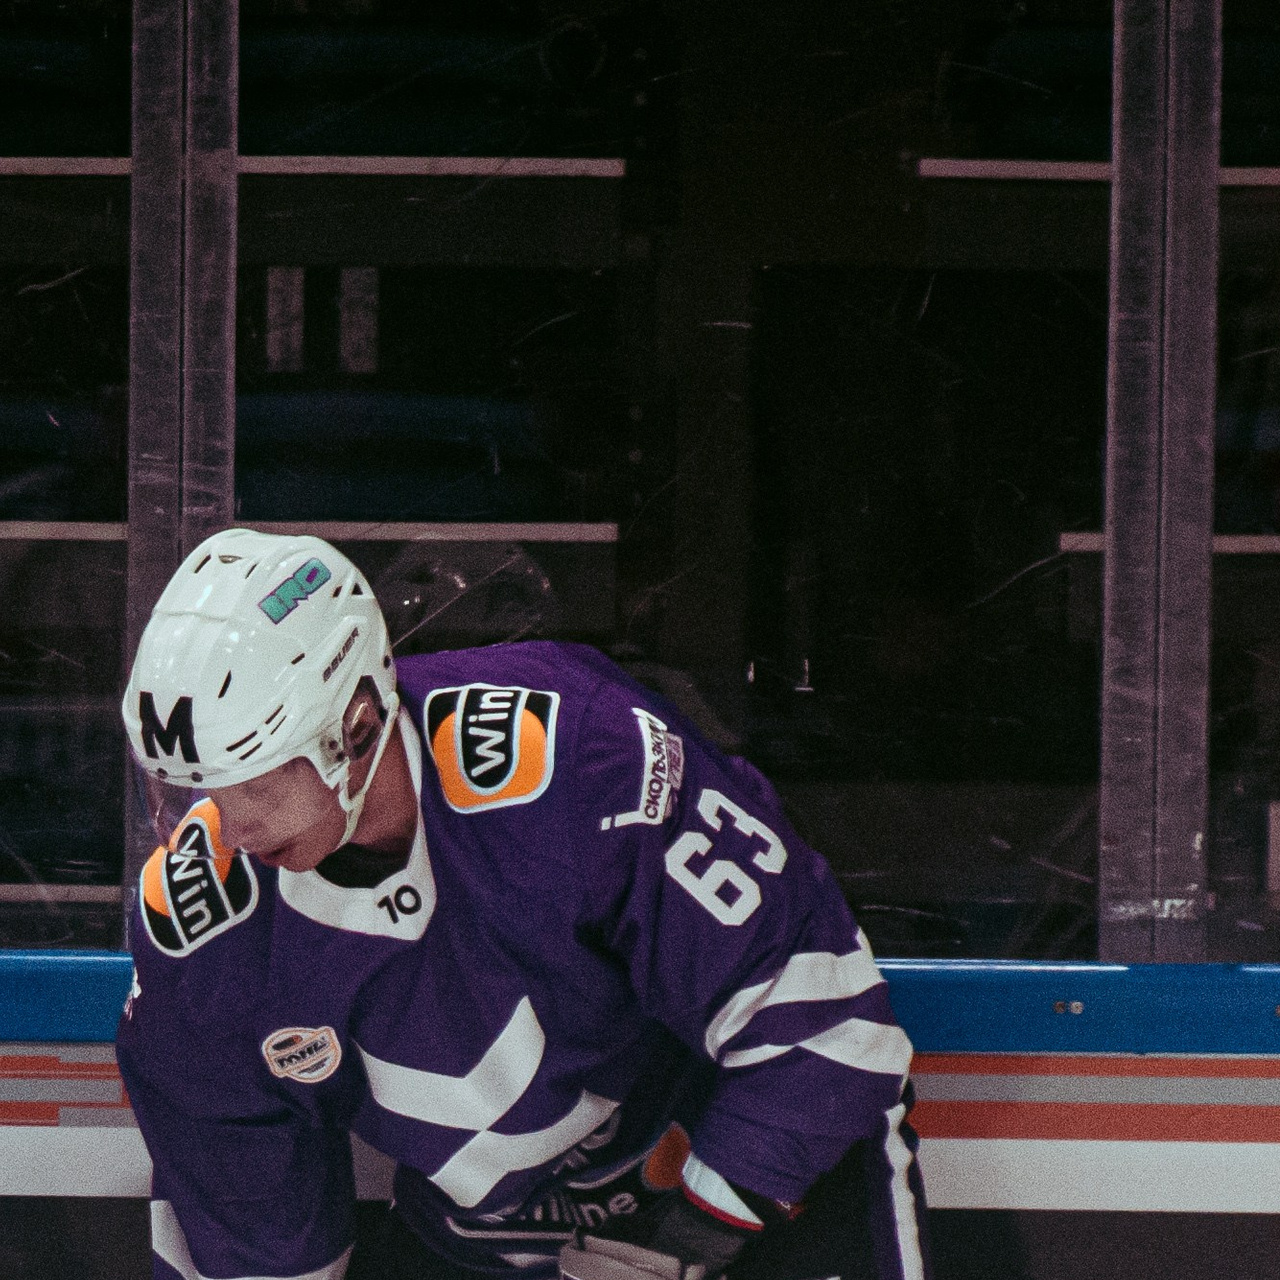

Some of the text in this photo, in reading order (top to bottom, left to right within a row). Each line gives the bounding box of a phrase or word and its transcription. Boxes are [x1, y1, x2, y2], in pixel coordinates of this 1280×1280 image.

[467, 690, 515, 777] Win
[169, 829, 213, 935] Win
[376, 885, 423, 925] 10
[665, 788, 789, 926] 63
